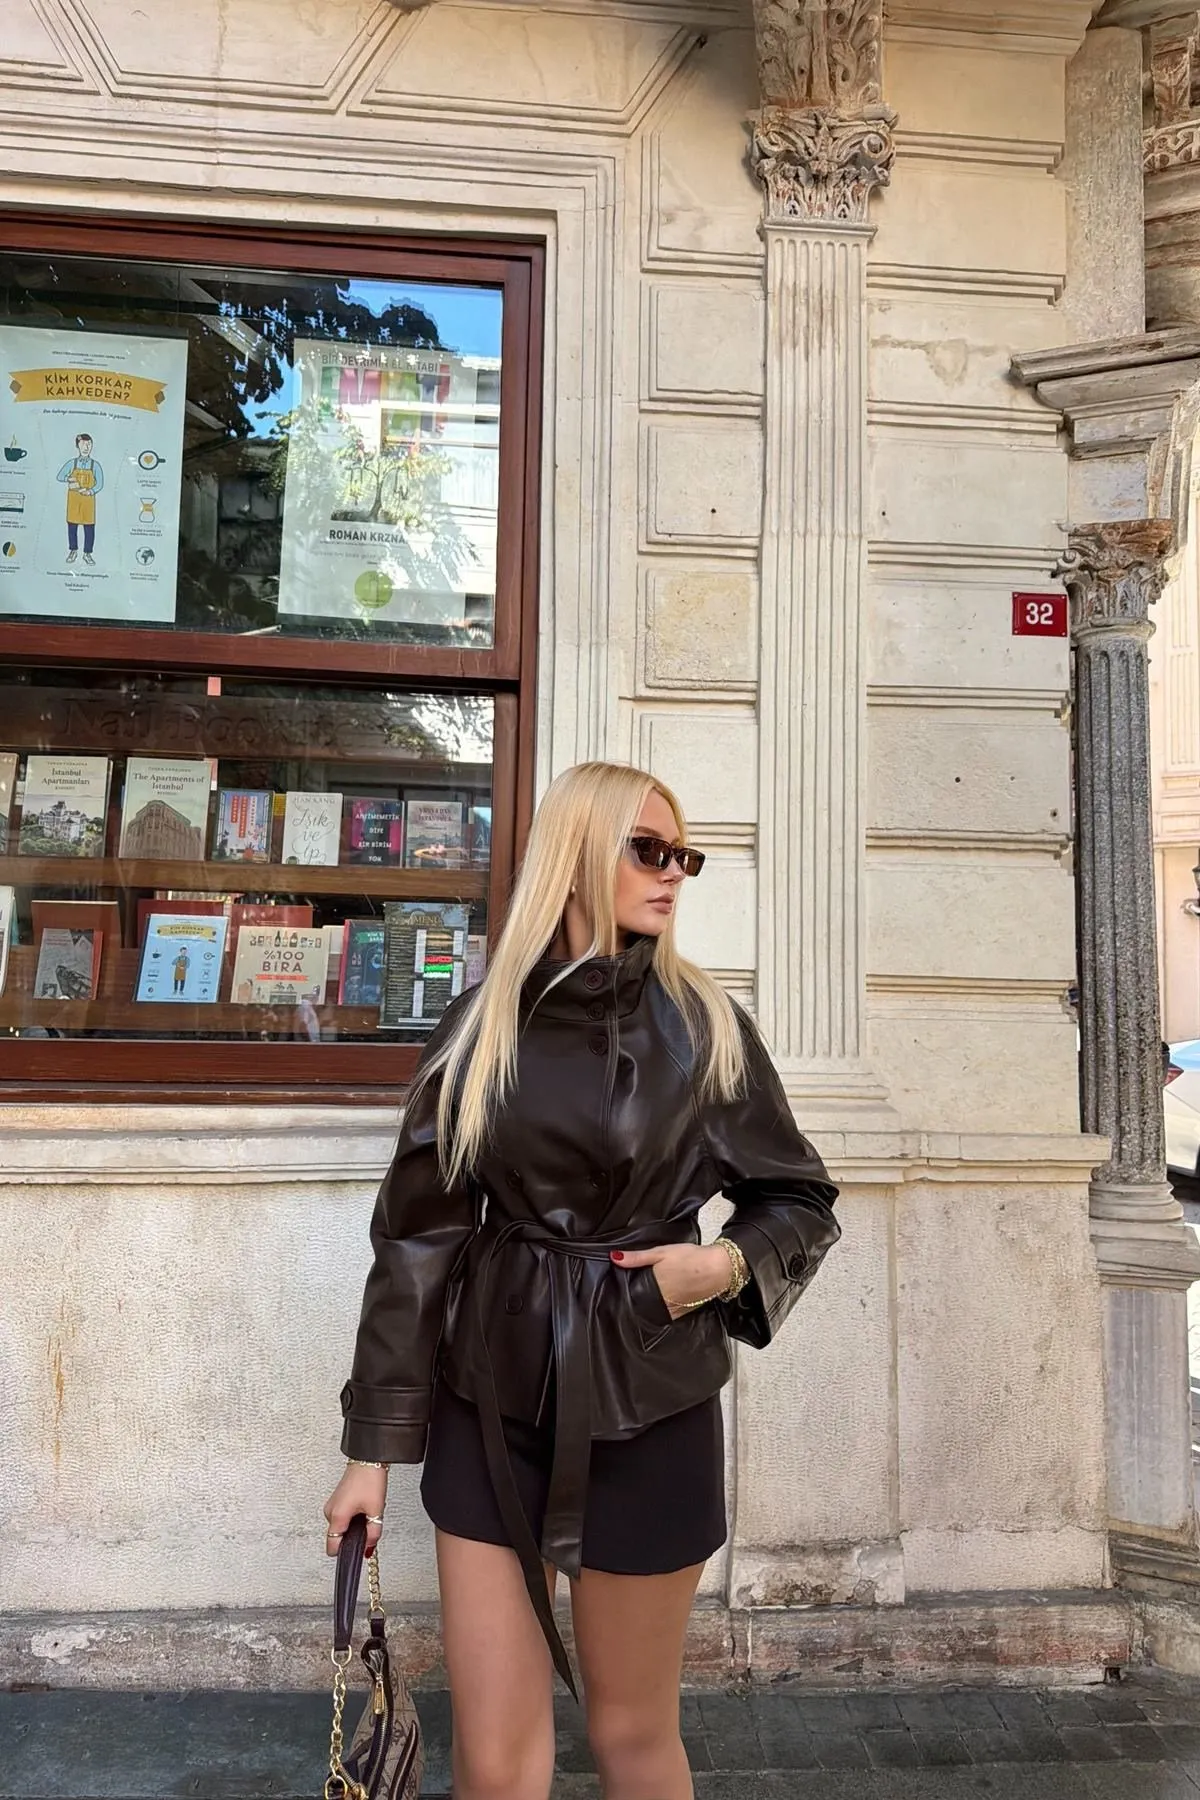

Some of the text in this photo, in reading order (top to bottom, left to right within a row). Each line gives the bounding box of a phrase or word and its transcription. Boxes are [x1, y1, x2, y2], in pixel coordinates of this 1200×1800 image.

[44, 372, 133, 390] KİM KORKAR
[46, 386, 130, 401] KAHVEDEN?
[329, 529, 408, 544] ROMAN KRZNA
[1026, 602, 1053, 625] 32
[263, 950, 305, 961] %100
